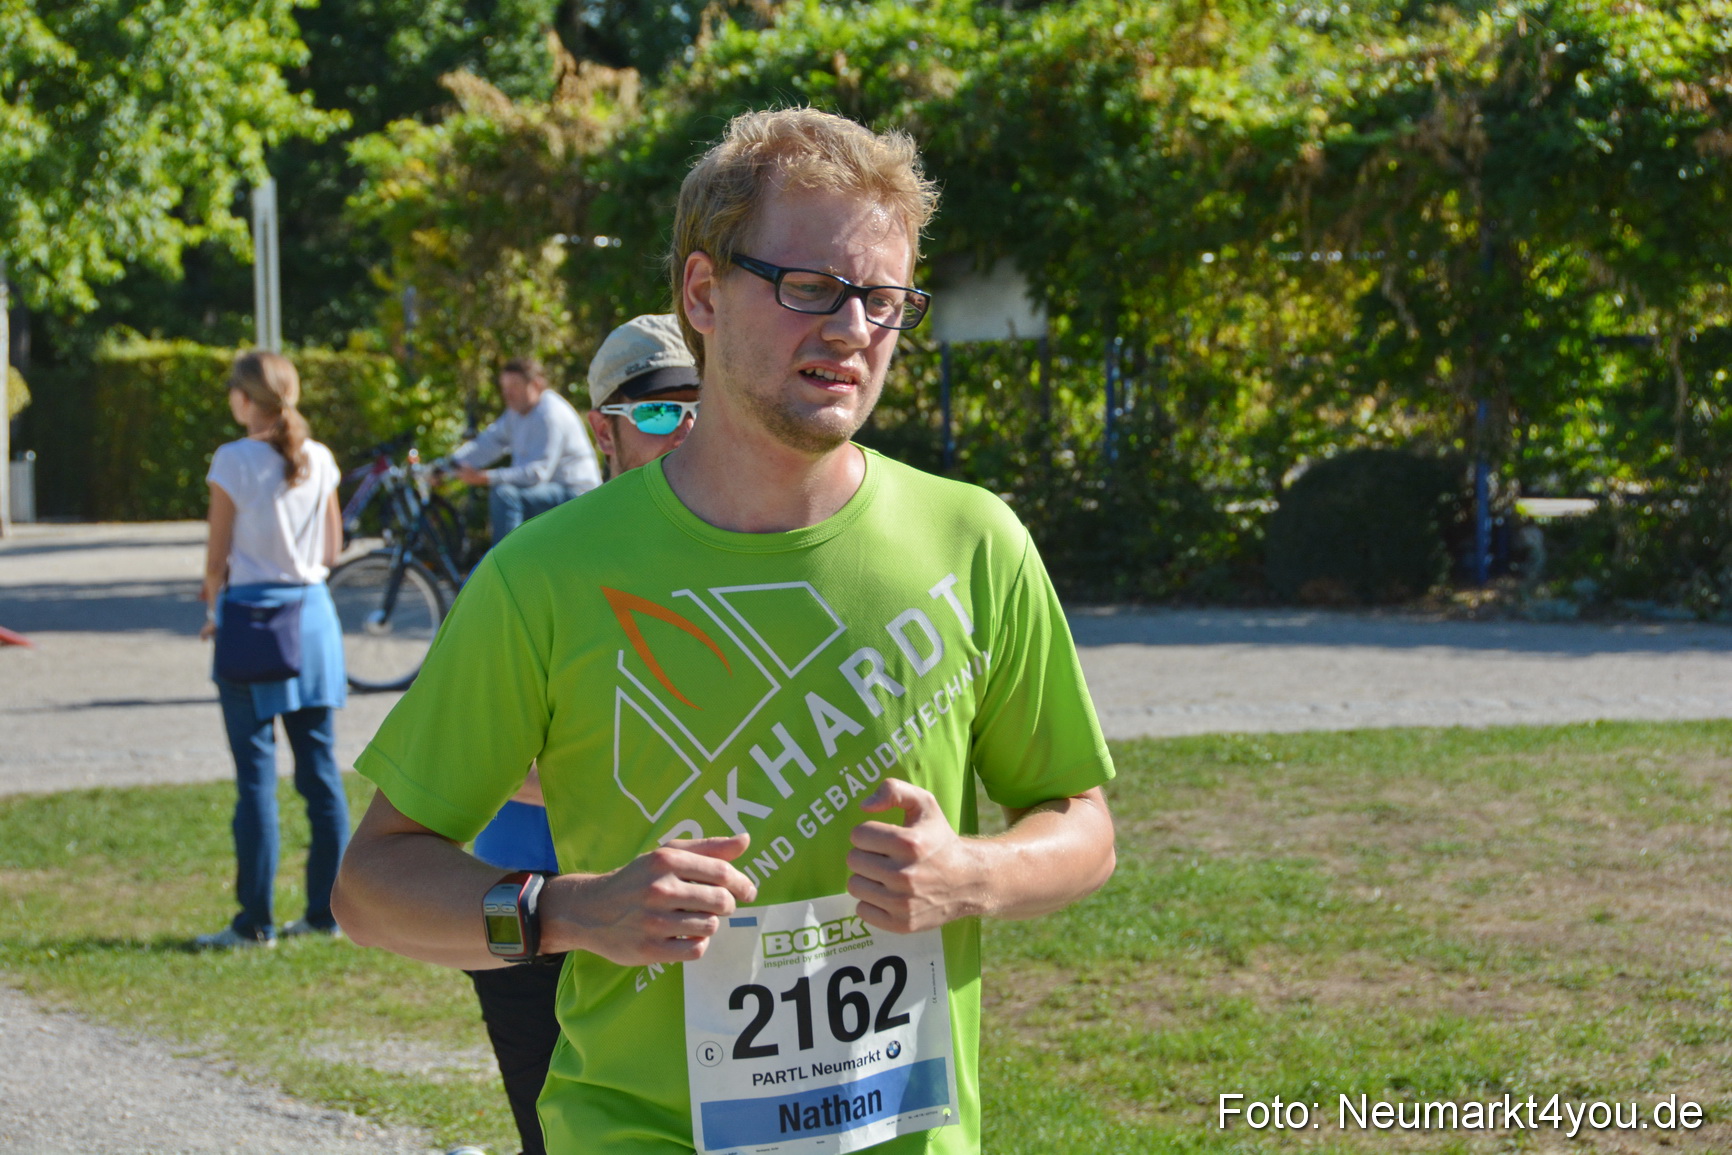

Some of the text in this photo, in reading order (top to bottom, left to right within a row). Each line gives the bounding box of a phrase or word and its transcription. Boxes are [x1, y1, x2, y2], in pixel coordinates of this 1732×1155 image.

[762, 915, 871, 959] BOCK
[764, 939, 874, 969] inspired by smart concepts
[728, 955, 911, 1060] 2162
[704, 1047, 715, 1062] C
[752, 1049, 882, 1087] PARTL Neumarkt
[778, 1088, 883, 1134] Nathan
